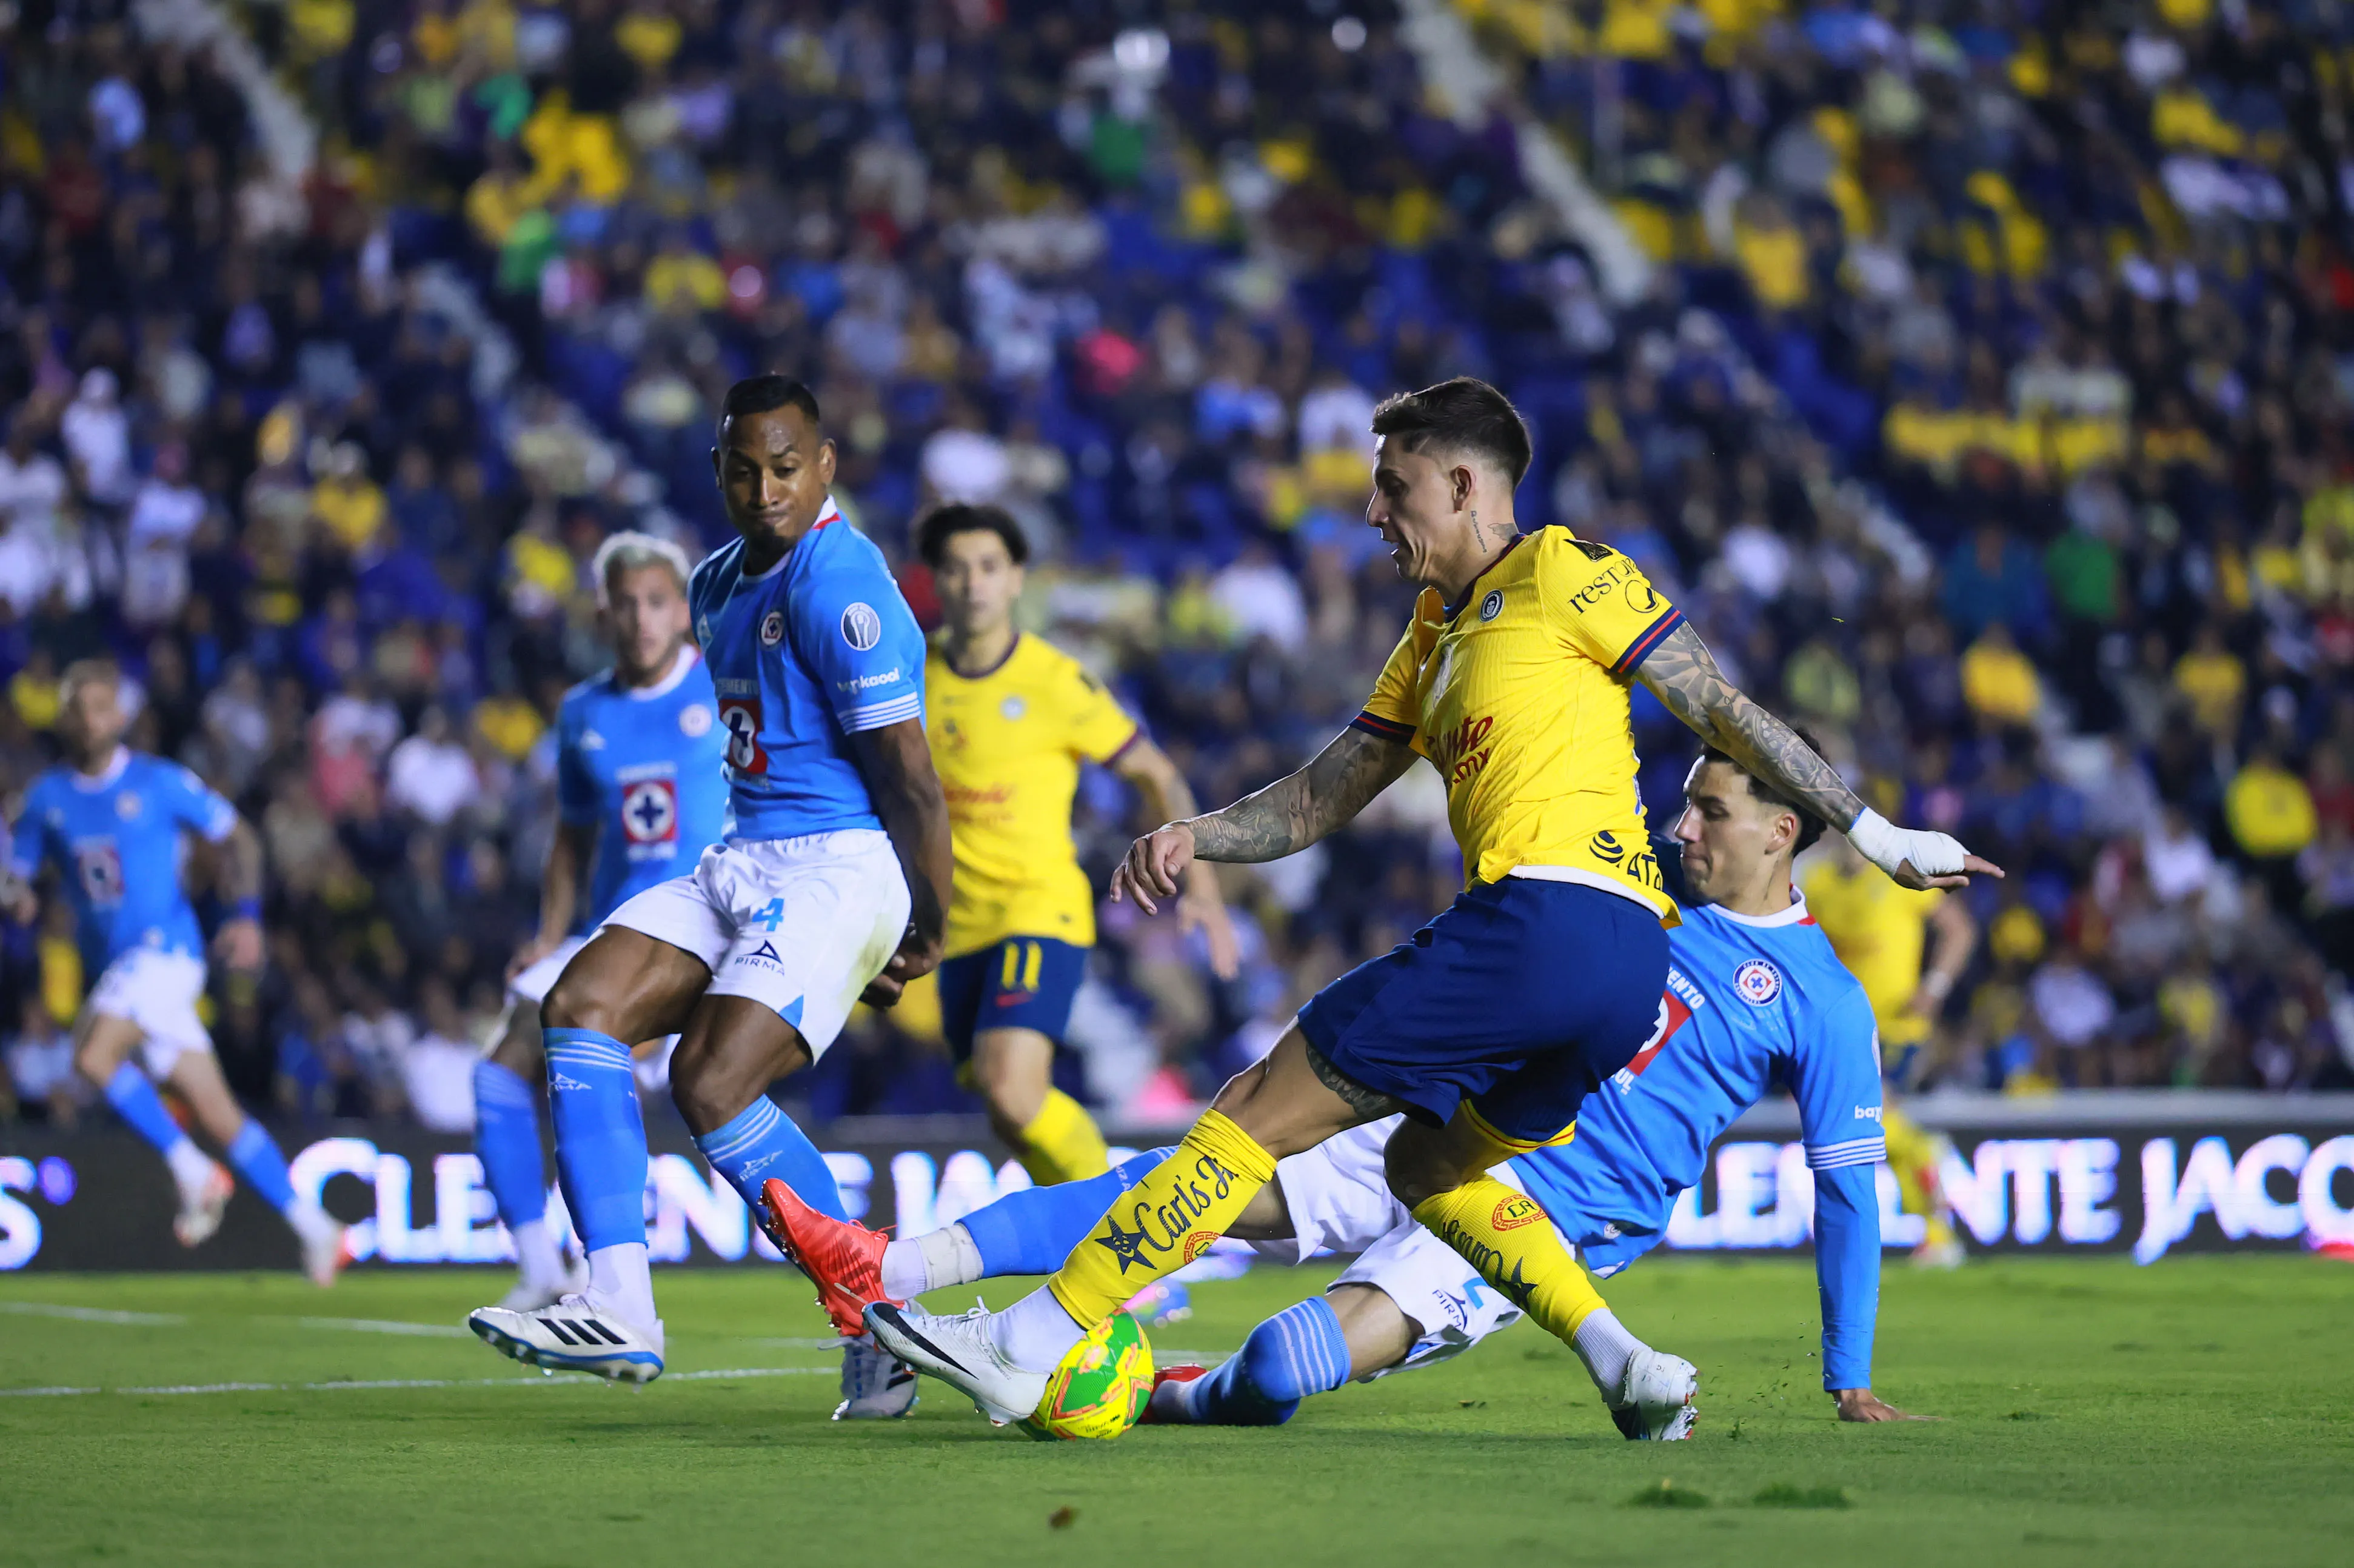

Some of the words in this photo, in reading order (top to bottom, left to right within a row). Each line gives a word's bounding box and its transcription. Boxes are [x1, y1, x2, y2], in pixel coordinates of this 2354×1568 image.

[752, 898, 785, 932] 4
[734, 956, 786, 976] PIRMA
[1000, 941, 1043, 990] 11
[1667, 966, 1706, 1009] ENTO
[1134, 1175, 1211, 1252] Carl's
[1432, 1289, 1463, 1328] PIRM
